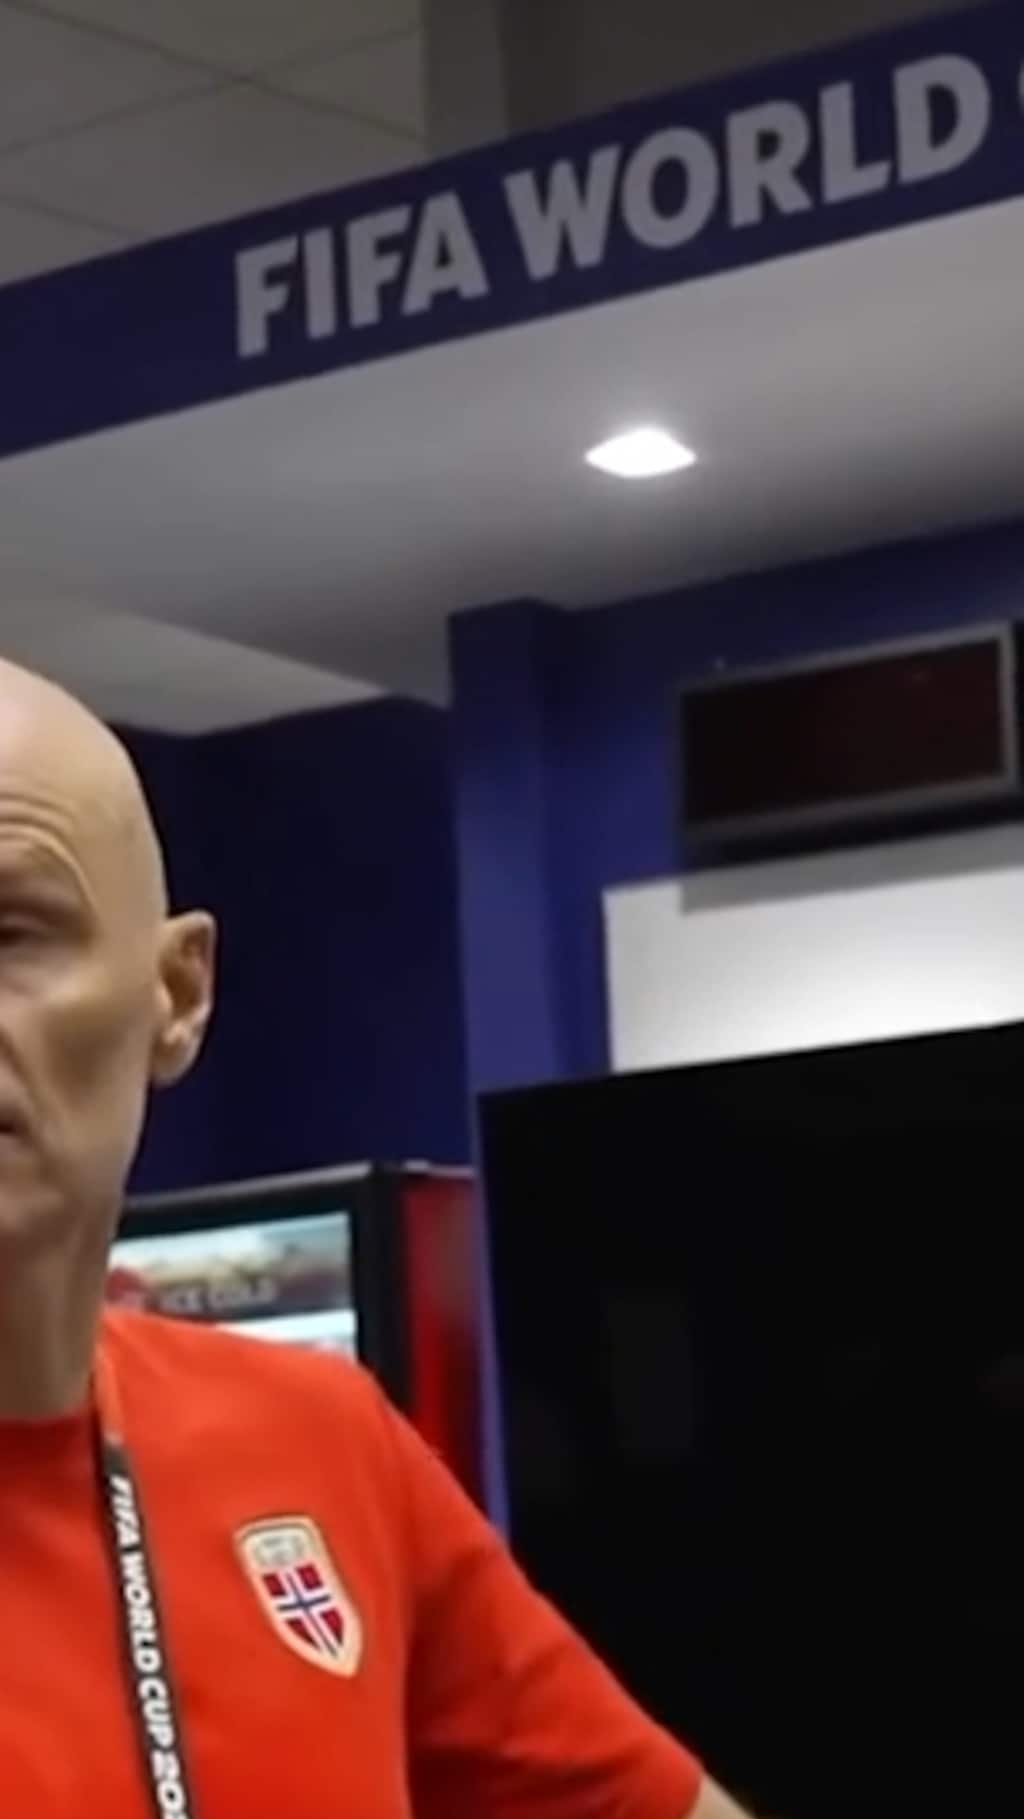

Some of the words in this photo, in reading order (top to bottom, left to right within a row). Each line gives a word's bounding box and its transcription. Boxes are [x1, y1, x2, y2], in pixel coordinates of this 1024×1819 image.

[235, 190, 488, 359] FIFA
[505, 52, 991, 281] WORLD
[110, 1474, 141, 1545] FIFA
[120, 1551, 162, 1673] WORLD
[138, 1677, 174, 1747] CUP
